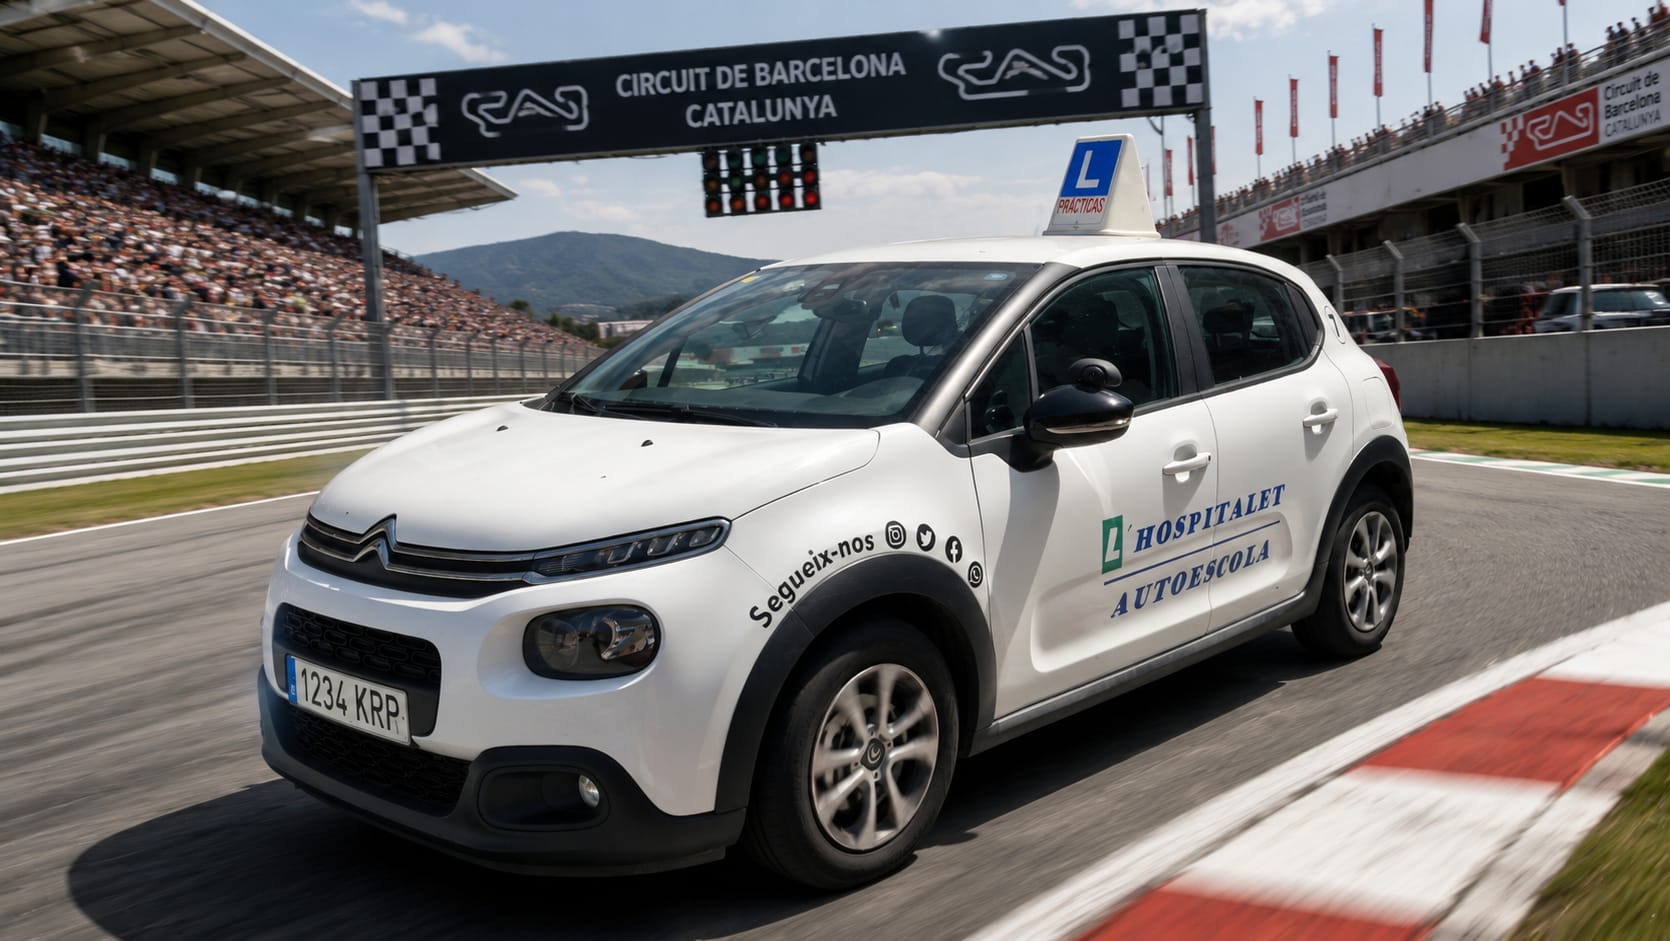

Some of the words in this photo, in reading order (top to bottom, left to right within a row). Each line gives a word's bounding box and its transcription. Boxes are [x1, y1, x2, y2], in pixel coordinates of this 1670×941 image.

[616, 67, 710, 98] CIRCUIT
[716, 64, 749, 90] DE
[754, 52, 906, 86] BARCELONA
[1605, 77, 1641, 100] Circuit
[1644, 70, 1660, 88] de
[685, 94, 838, 128] CATALUNYA
[1605, 92, 1661, 119] Barcelona
[1075, 150, 1100, 189] L
[749, 534, 875, 629] Segueix-nos
[1110, 540, 1269, 618] AUTOESCOLA
[302, 668, 347, 717] 1234
